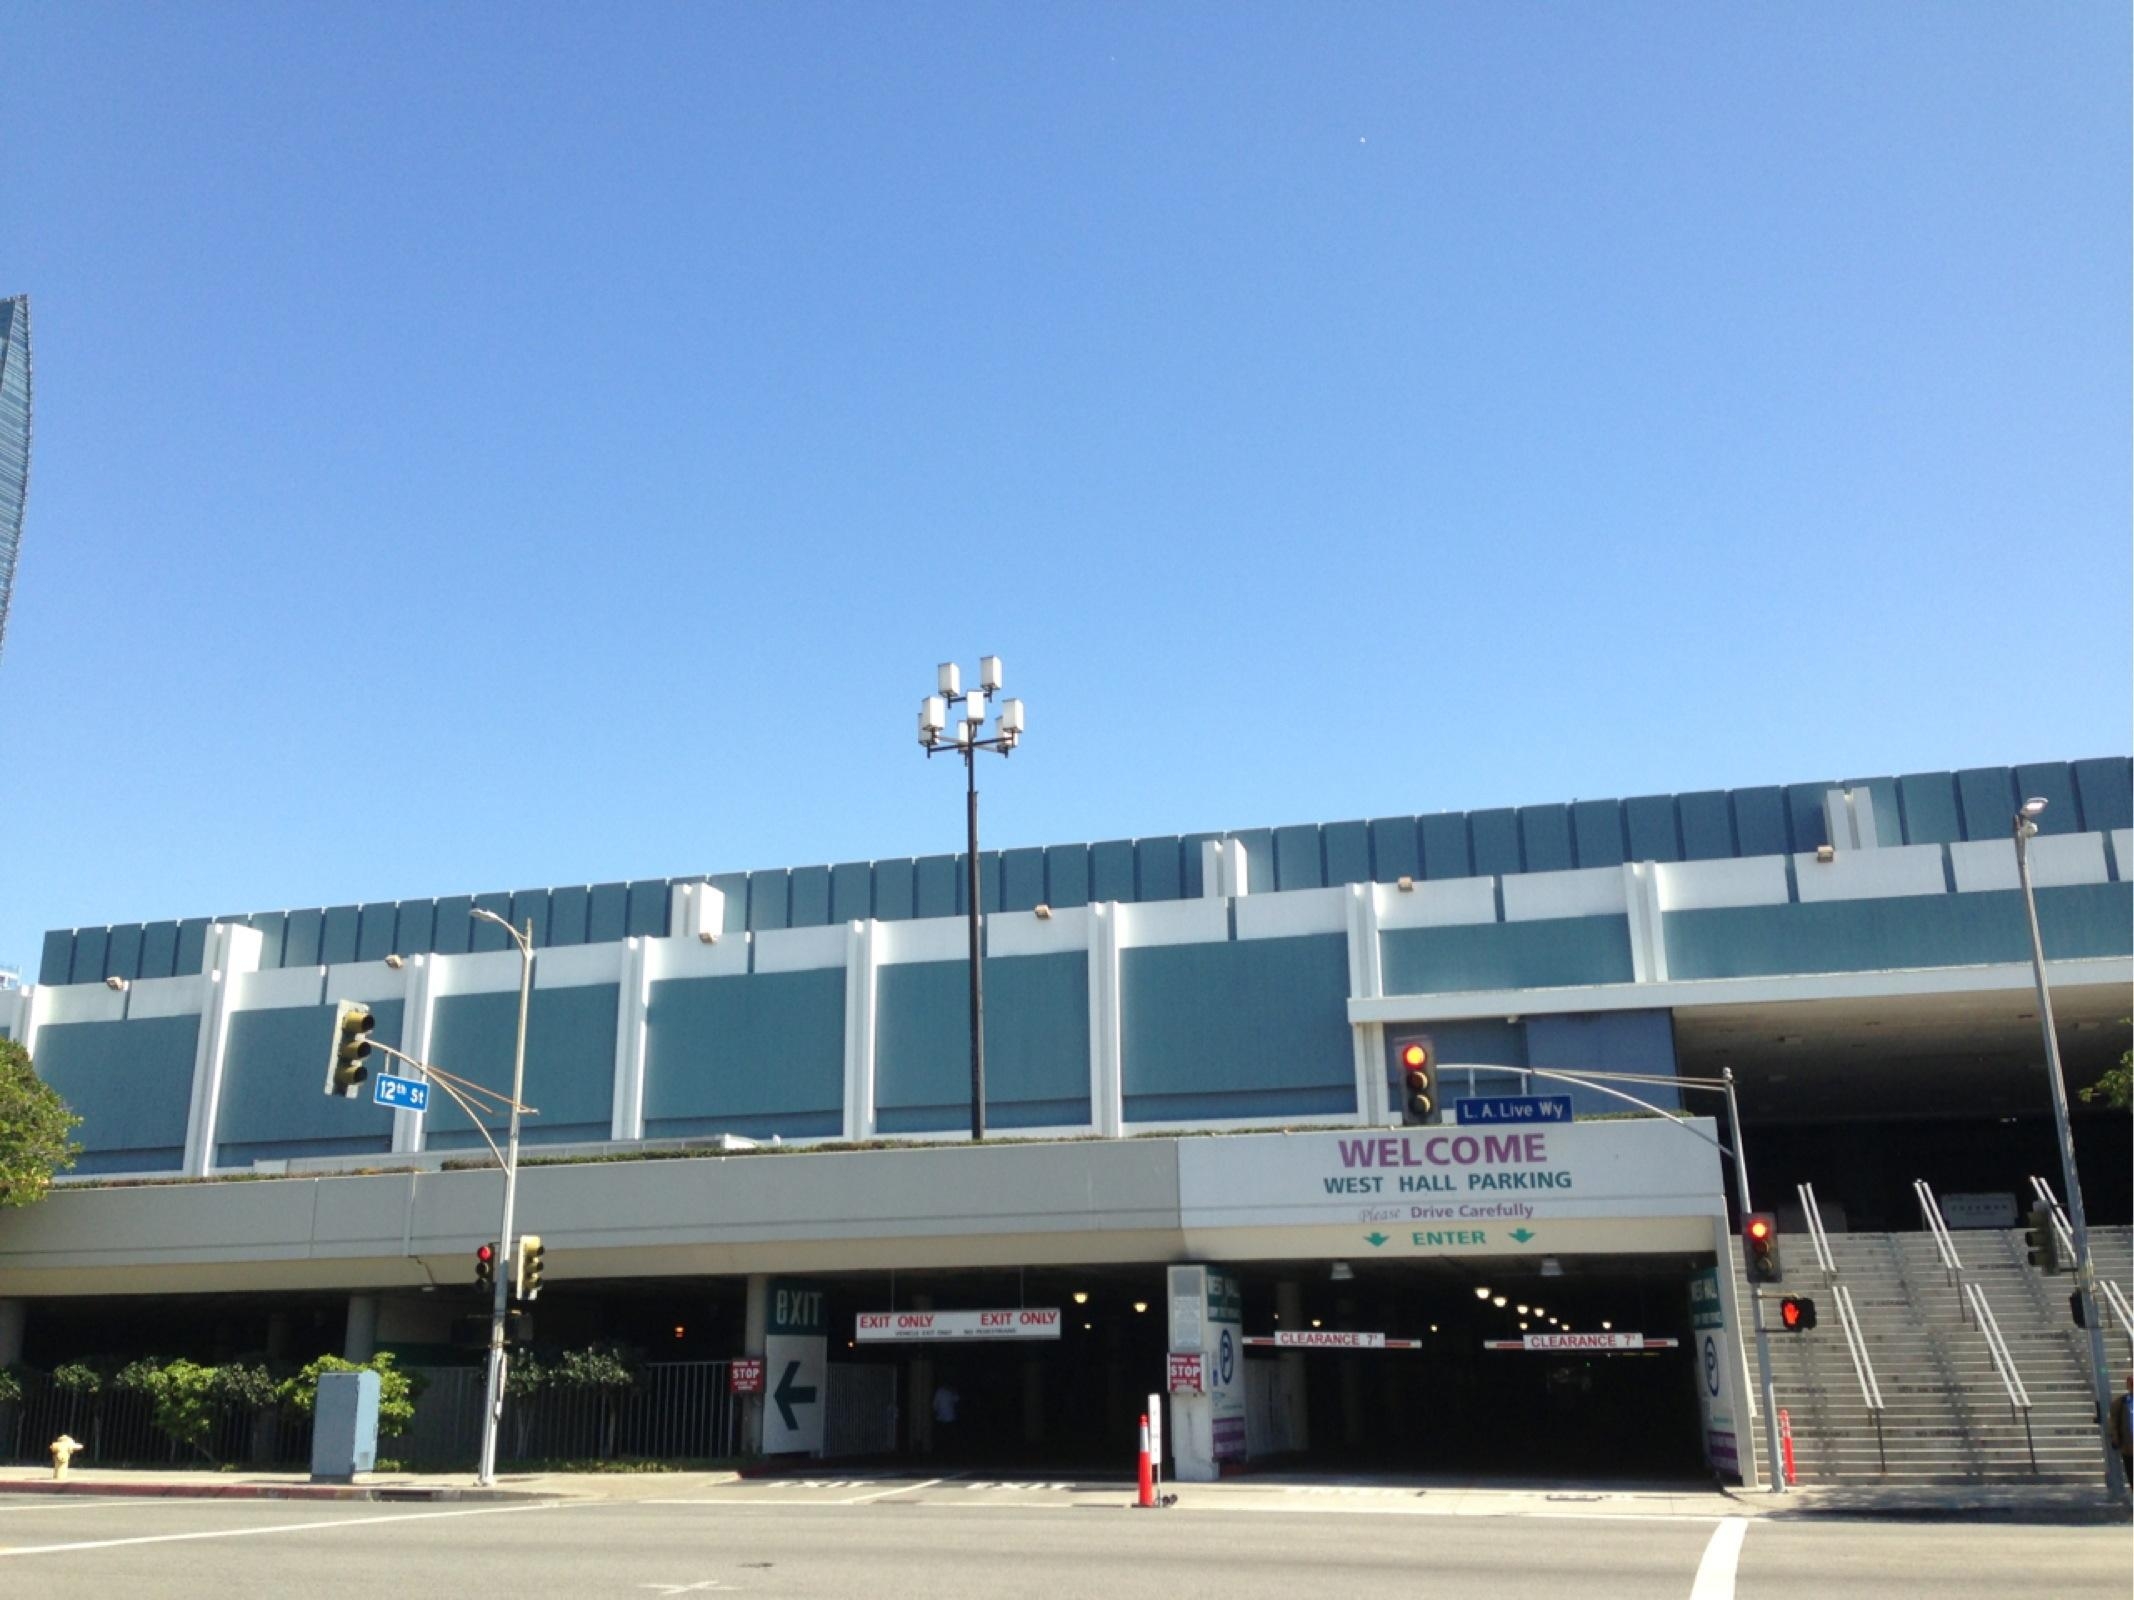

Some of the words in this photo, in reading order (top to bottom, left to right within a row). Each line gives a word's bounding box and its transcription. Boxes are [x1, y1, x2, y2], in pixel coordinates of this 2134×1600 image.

[381, 1080, 407, 1100] 12th
[410, 1087, 423, 1104] St
[1500, 1102, 1533, 1118] Live
[1540, 1101, 1563, 1119] Wy
[1338, 1133, 1548, 1168] WELCOME
[1324, 1176, 1383, 1194] WEST
[1400, 1174, 1457, 1192] HALL
[1467, 1171, 1572, 1190] PARKING
[1358, 1206, 1400, 1223] Please
[1411, 1206, 1454, 1219] Drive
[1459, 1203, 1534, 1219] Carefully
[1412, 1231, 1486, 1246] ENTER
[860, 1316, 891, 1329] EXIT
[897, 1315, 935, 1328] ONLY
[981, 1313, 1013, 1326] EXIT
[1019, 1312, 1057, 1325] ONLY
[1280, 1333, 1360, 1345] CLEARANCE
[1531, 1335, 1616, 1348] CLEARANCE
[732, 1368, 760, 1379] STOP
[1170, 1366, 1200, 1377] STOP
